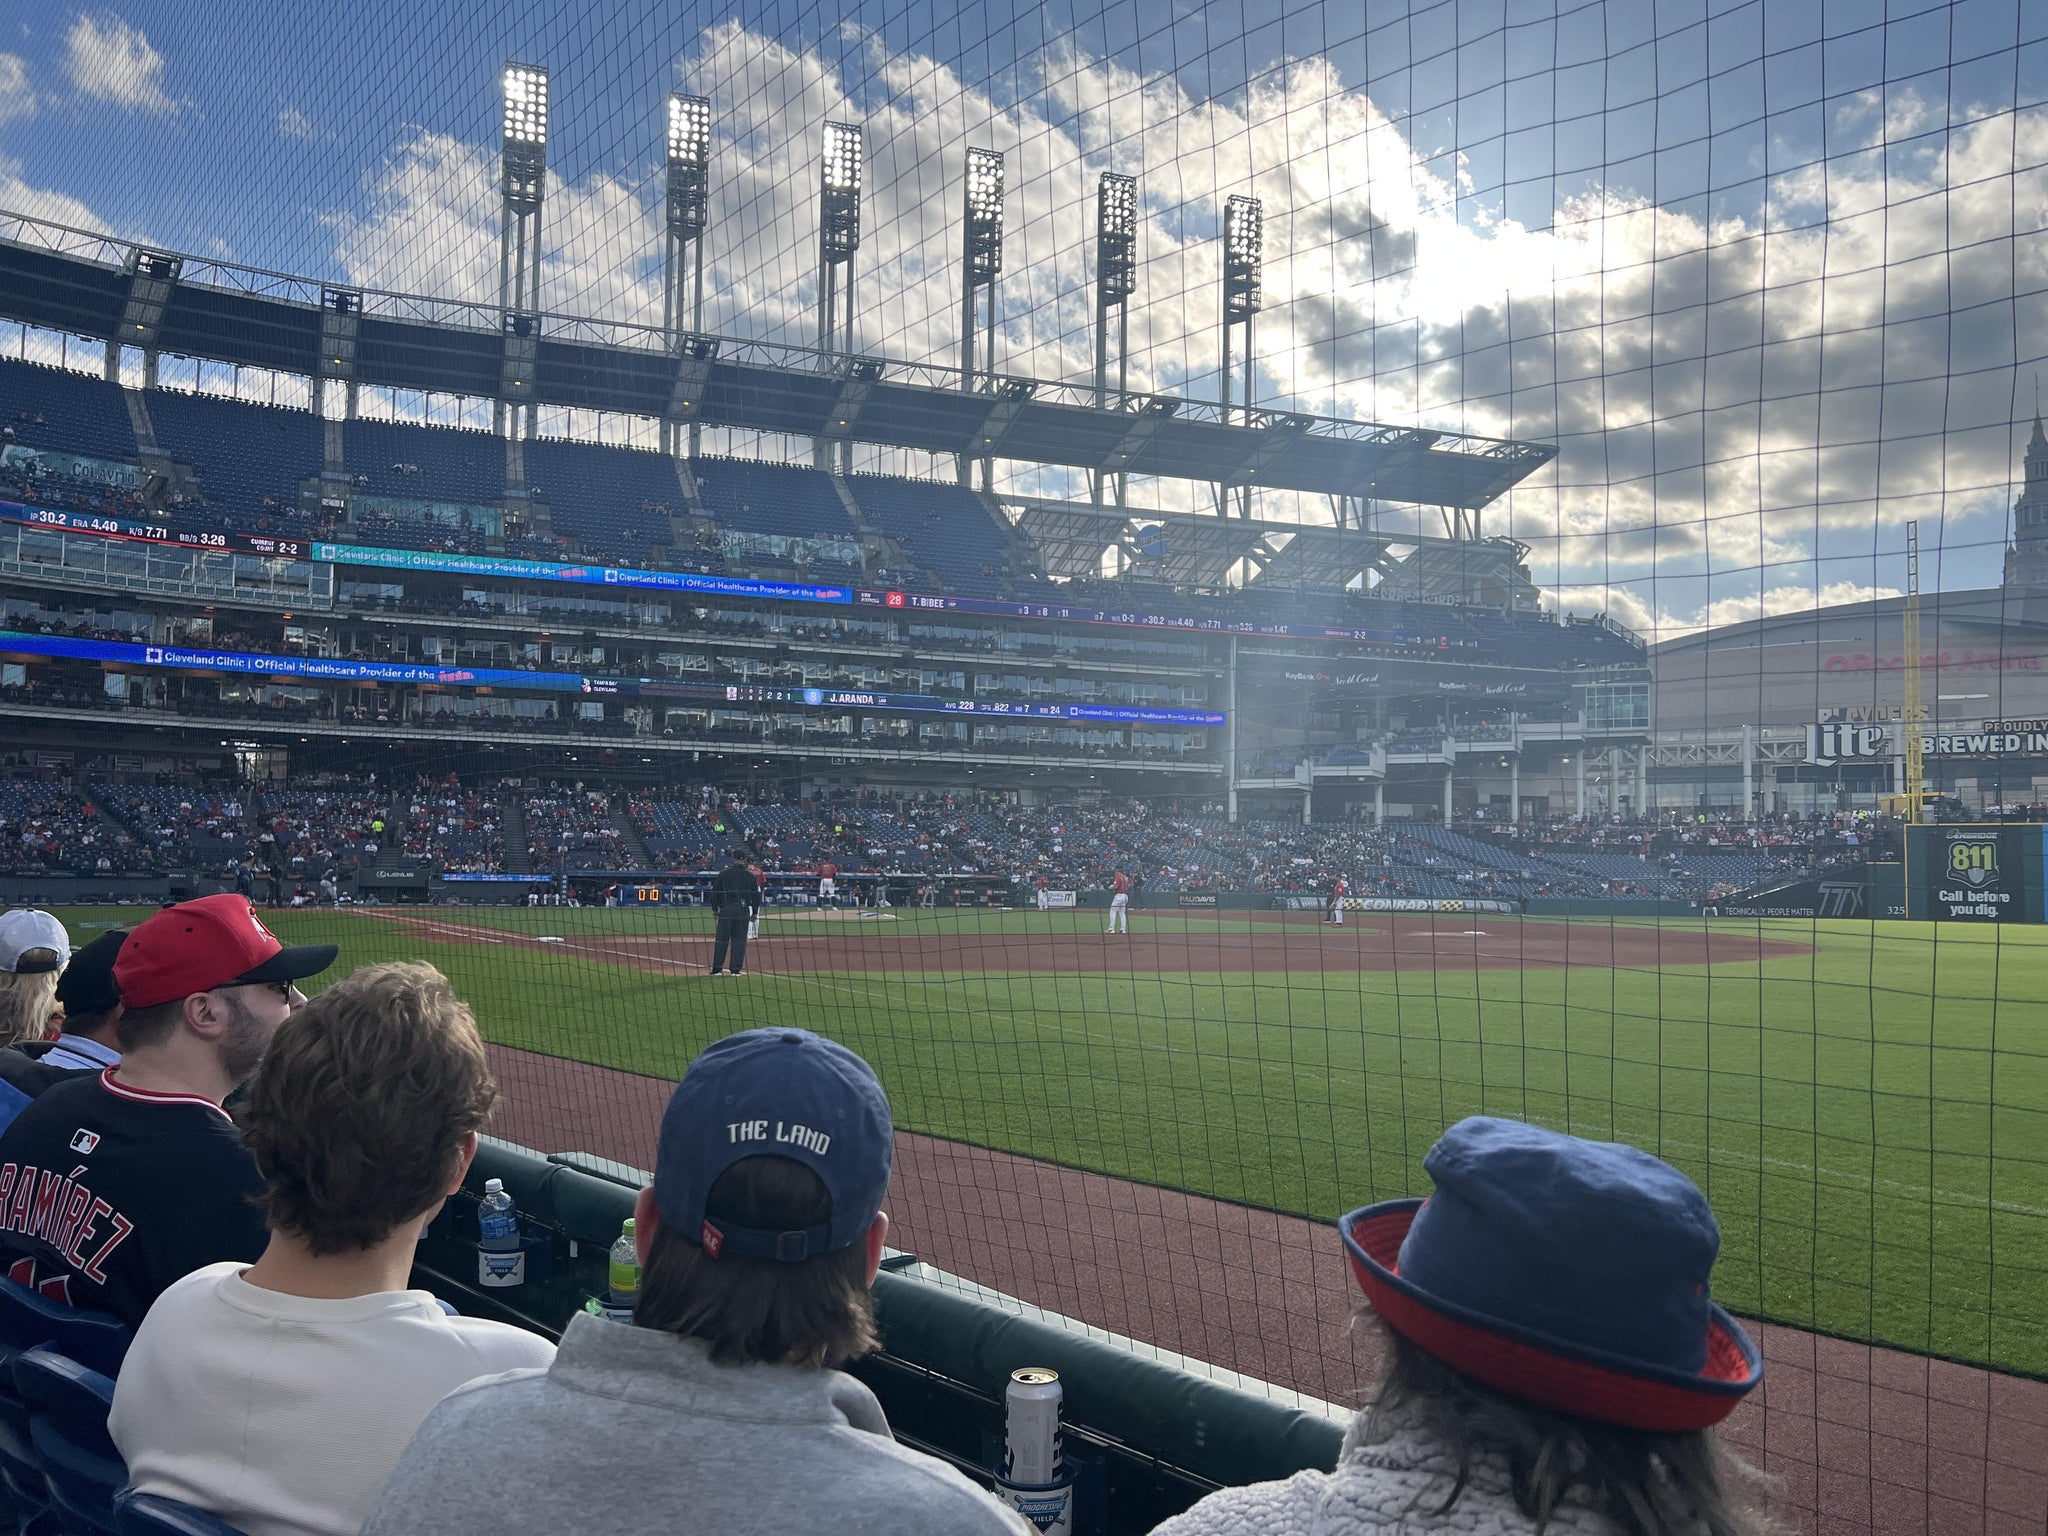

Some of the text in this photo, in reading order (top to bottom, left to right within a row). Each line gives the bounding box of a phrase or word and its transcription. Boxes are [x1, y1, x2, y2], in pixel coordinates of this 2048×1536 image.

[40, 511, 66, 524] 30.2
[73, 520, 88, 528] ERA
[91, 519, 118, 532] 4.40
[146, 526, 168, 539] 7.71
[280, 542, 298, 554] 2-2
[414, 557, 445, 566] Official
[448, 560, 493, 570] Healthcare
[495, 563, 530, 574] Provider
[620, 572, 656, 584] Cleveland
[658, 576, 678, 586] Clinic
[686, 580, 716, 589] Official
[718, 582, 758, 592] Healthcare
[760, 586, 790, 595] Provider
[889, 596, 902, 605] 28
[912, 597, 920, 606] T.
[920, 598, 944, 608] BIBEE
[1024, 606, 1029, 614] 3
[1042, 608, 1048, 616] 8
[1062, 610, 1069, 618] 11
[1099, 612, 1104, 620] 7
[1122, 614, 1136, 622] 0-3
[1148, 616, 1164, 625] 30.2
[1178, 618, 1194, 627] 4.40
[1207, 620, 1221, 630] 7.71
[1274, 625, 1288, 634] 1.47
[1354, 630, 1366, 640] 2-2
[164, 652, 214, 665] Cleveland
[216, 656, 245, 667] Clinic
[254, 659, 296, 671] Official
[300, 662, 356, 676] Healthcare
[360, 667, 402, 678] Provider
[404, 670, 415, 679] of
[419, 670, 435, 680] the
[1285, 672, 1315, 681] KeyBank
[1438, 681, 1467, 690] KeyBank
[830, 694, 838, 703] J.
[838, 694, 874, 704] ARANDA
[957, 701, 974, 710] .228
[992, 704, 1009, 712] .822
[1024, 704, 1030, 713] 7
[1050, 706, 1060, 714] 24
[1984, 720, 2048, 733] PROUDLY
[1802, 724, 1884, 767] Lite
[1922, 734, 2020, 754] BREWED
[1953, 845, 1992, 870] 811
[1939, 890, 2010, 902] Call before
[1768, 908, 1790, 916] PEOPLE
[1791, 908, 1814, 916] MATTER
[1887, 906, 1905, 914] 325
[1950, 904, 1998, 918] you dig.
[727, 1120, 831, 1156] THE LAND
[0, 1163, 134, 1286] RAMÍREZ
